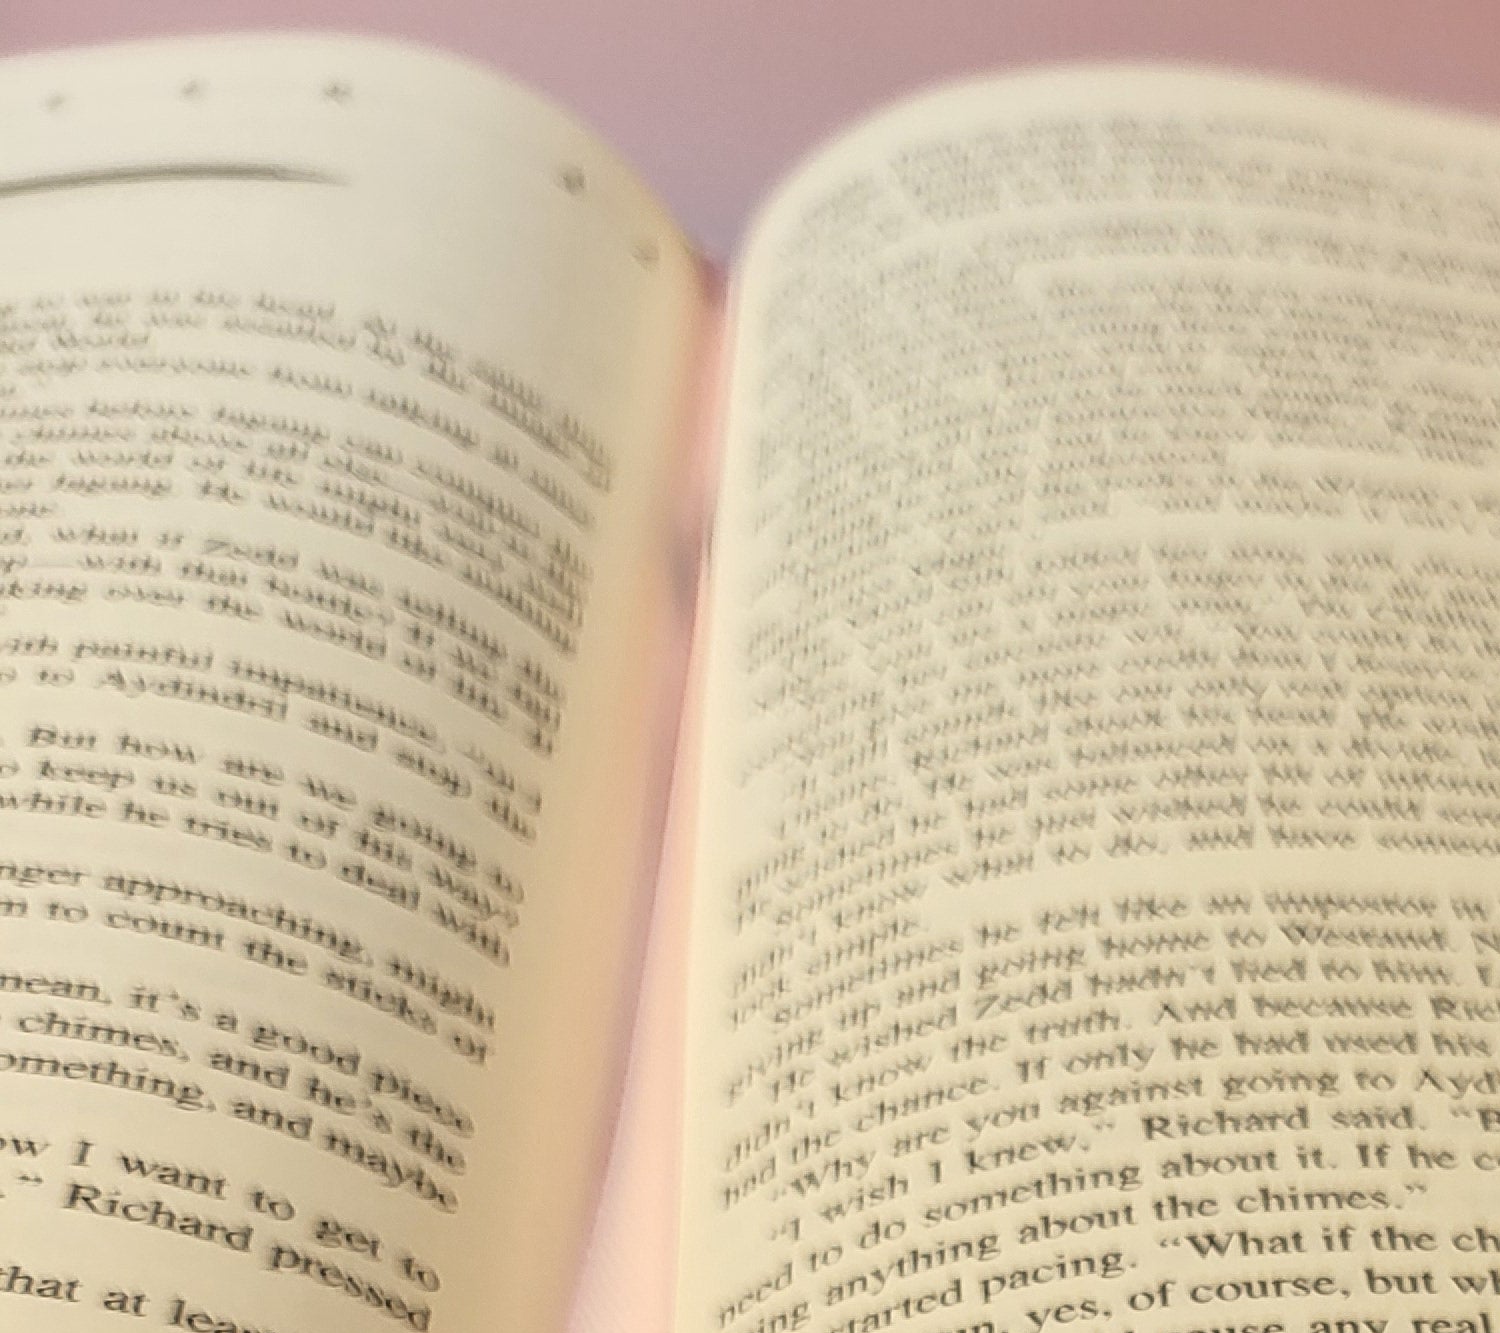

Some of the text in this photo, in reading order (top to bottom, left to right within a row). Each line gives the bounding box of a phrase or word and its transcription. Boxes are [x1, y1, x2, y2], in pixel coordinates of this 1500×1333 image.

[230, 1100, 313, 1141] and
[321, 1127, 458, 1214] maybe
[62, 1180, 253, 1253] Richard
[71, 1138, 91, 1167] I
[117, 1152, 226, 1201] want
[249, 1189, 295, 1222] to
[312, 1215, 381, 1262] get
[397, 1254, 441, 1293] to
[825, 1232, 1000, 1307] anything
[1018, 1202, 1134, 1245] about
[1151, 1192, 1219, 1222] the
[1234, 1181, 1427, 1214] chimes."
[1159, 1228, 1306, 1258] "What
[1321, 1222, 1356, 1253] if
[1369, 1223, 1437, 1252] the
[102, 1290, 146, 1318] at
[1127, 1278, 1176, 1311] of
[1364, 1266, 1437, 1295] but
